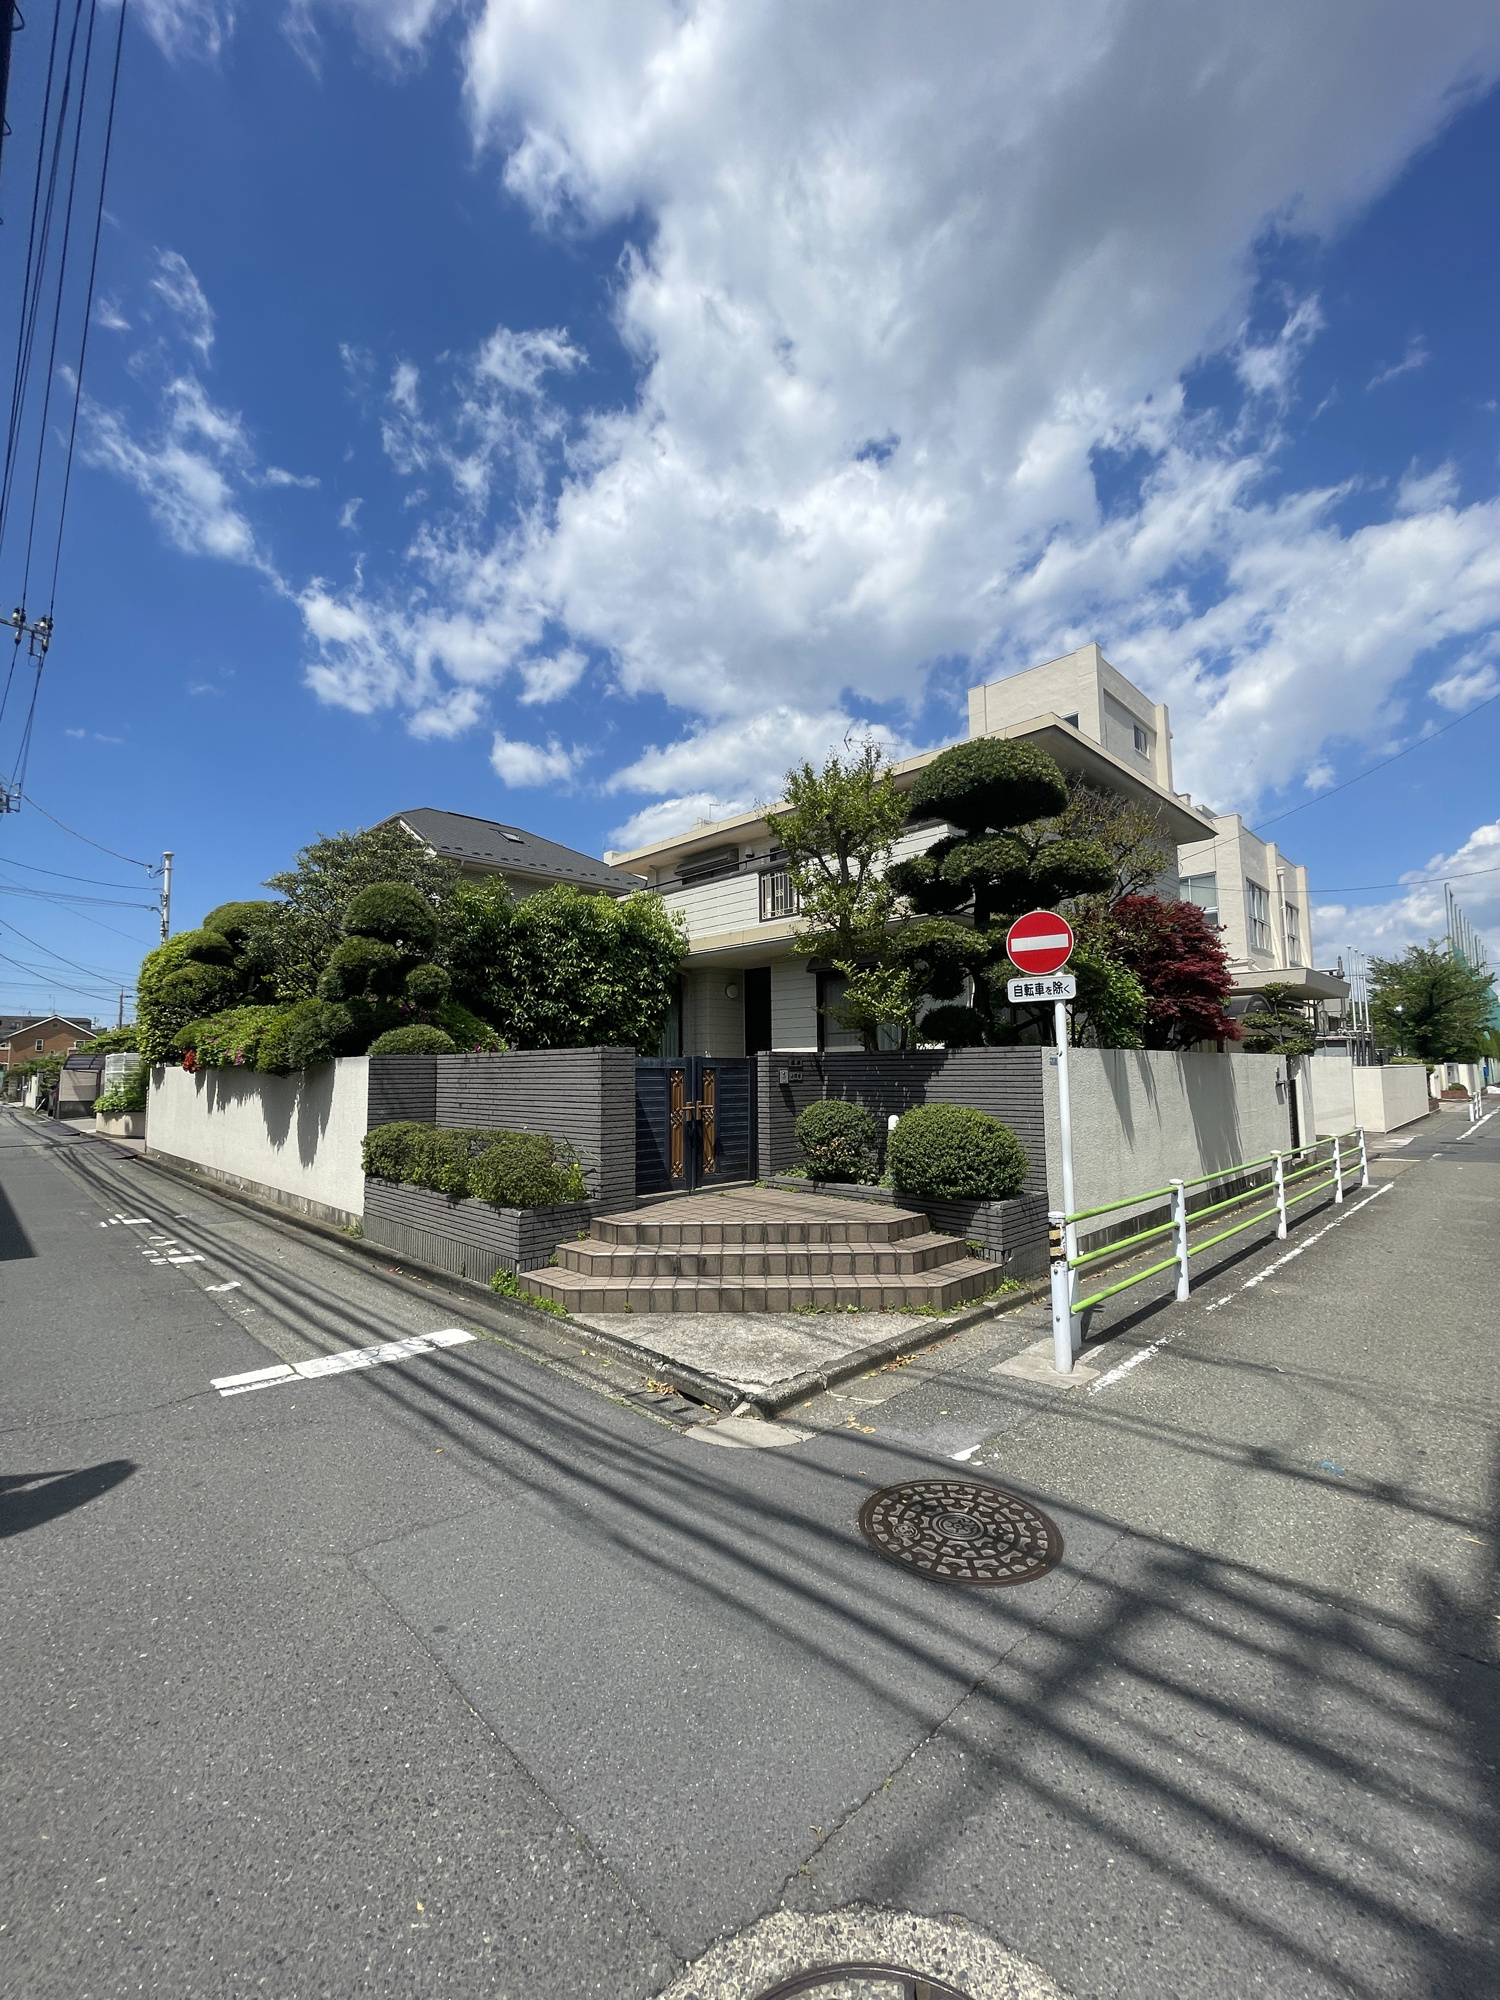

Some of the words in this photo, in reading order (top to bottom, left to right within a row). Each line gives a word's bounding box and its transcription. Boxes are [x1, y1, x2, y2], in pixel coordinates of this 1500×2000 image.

[1014, 981, 1070, 997] 自転車を除く
